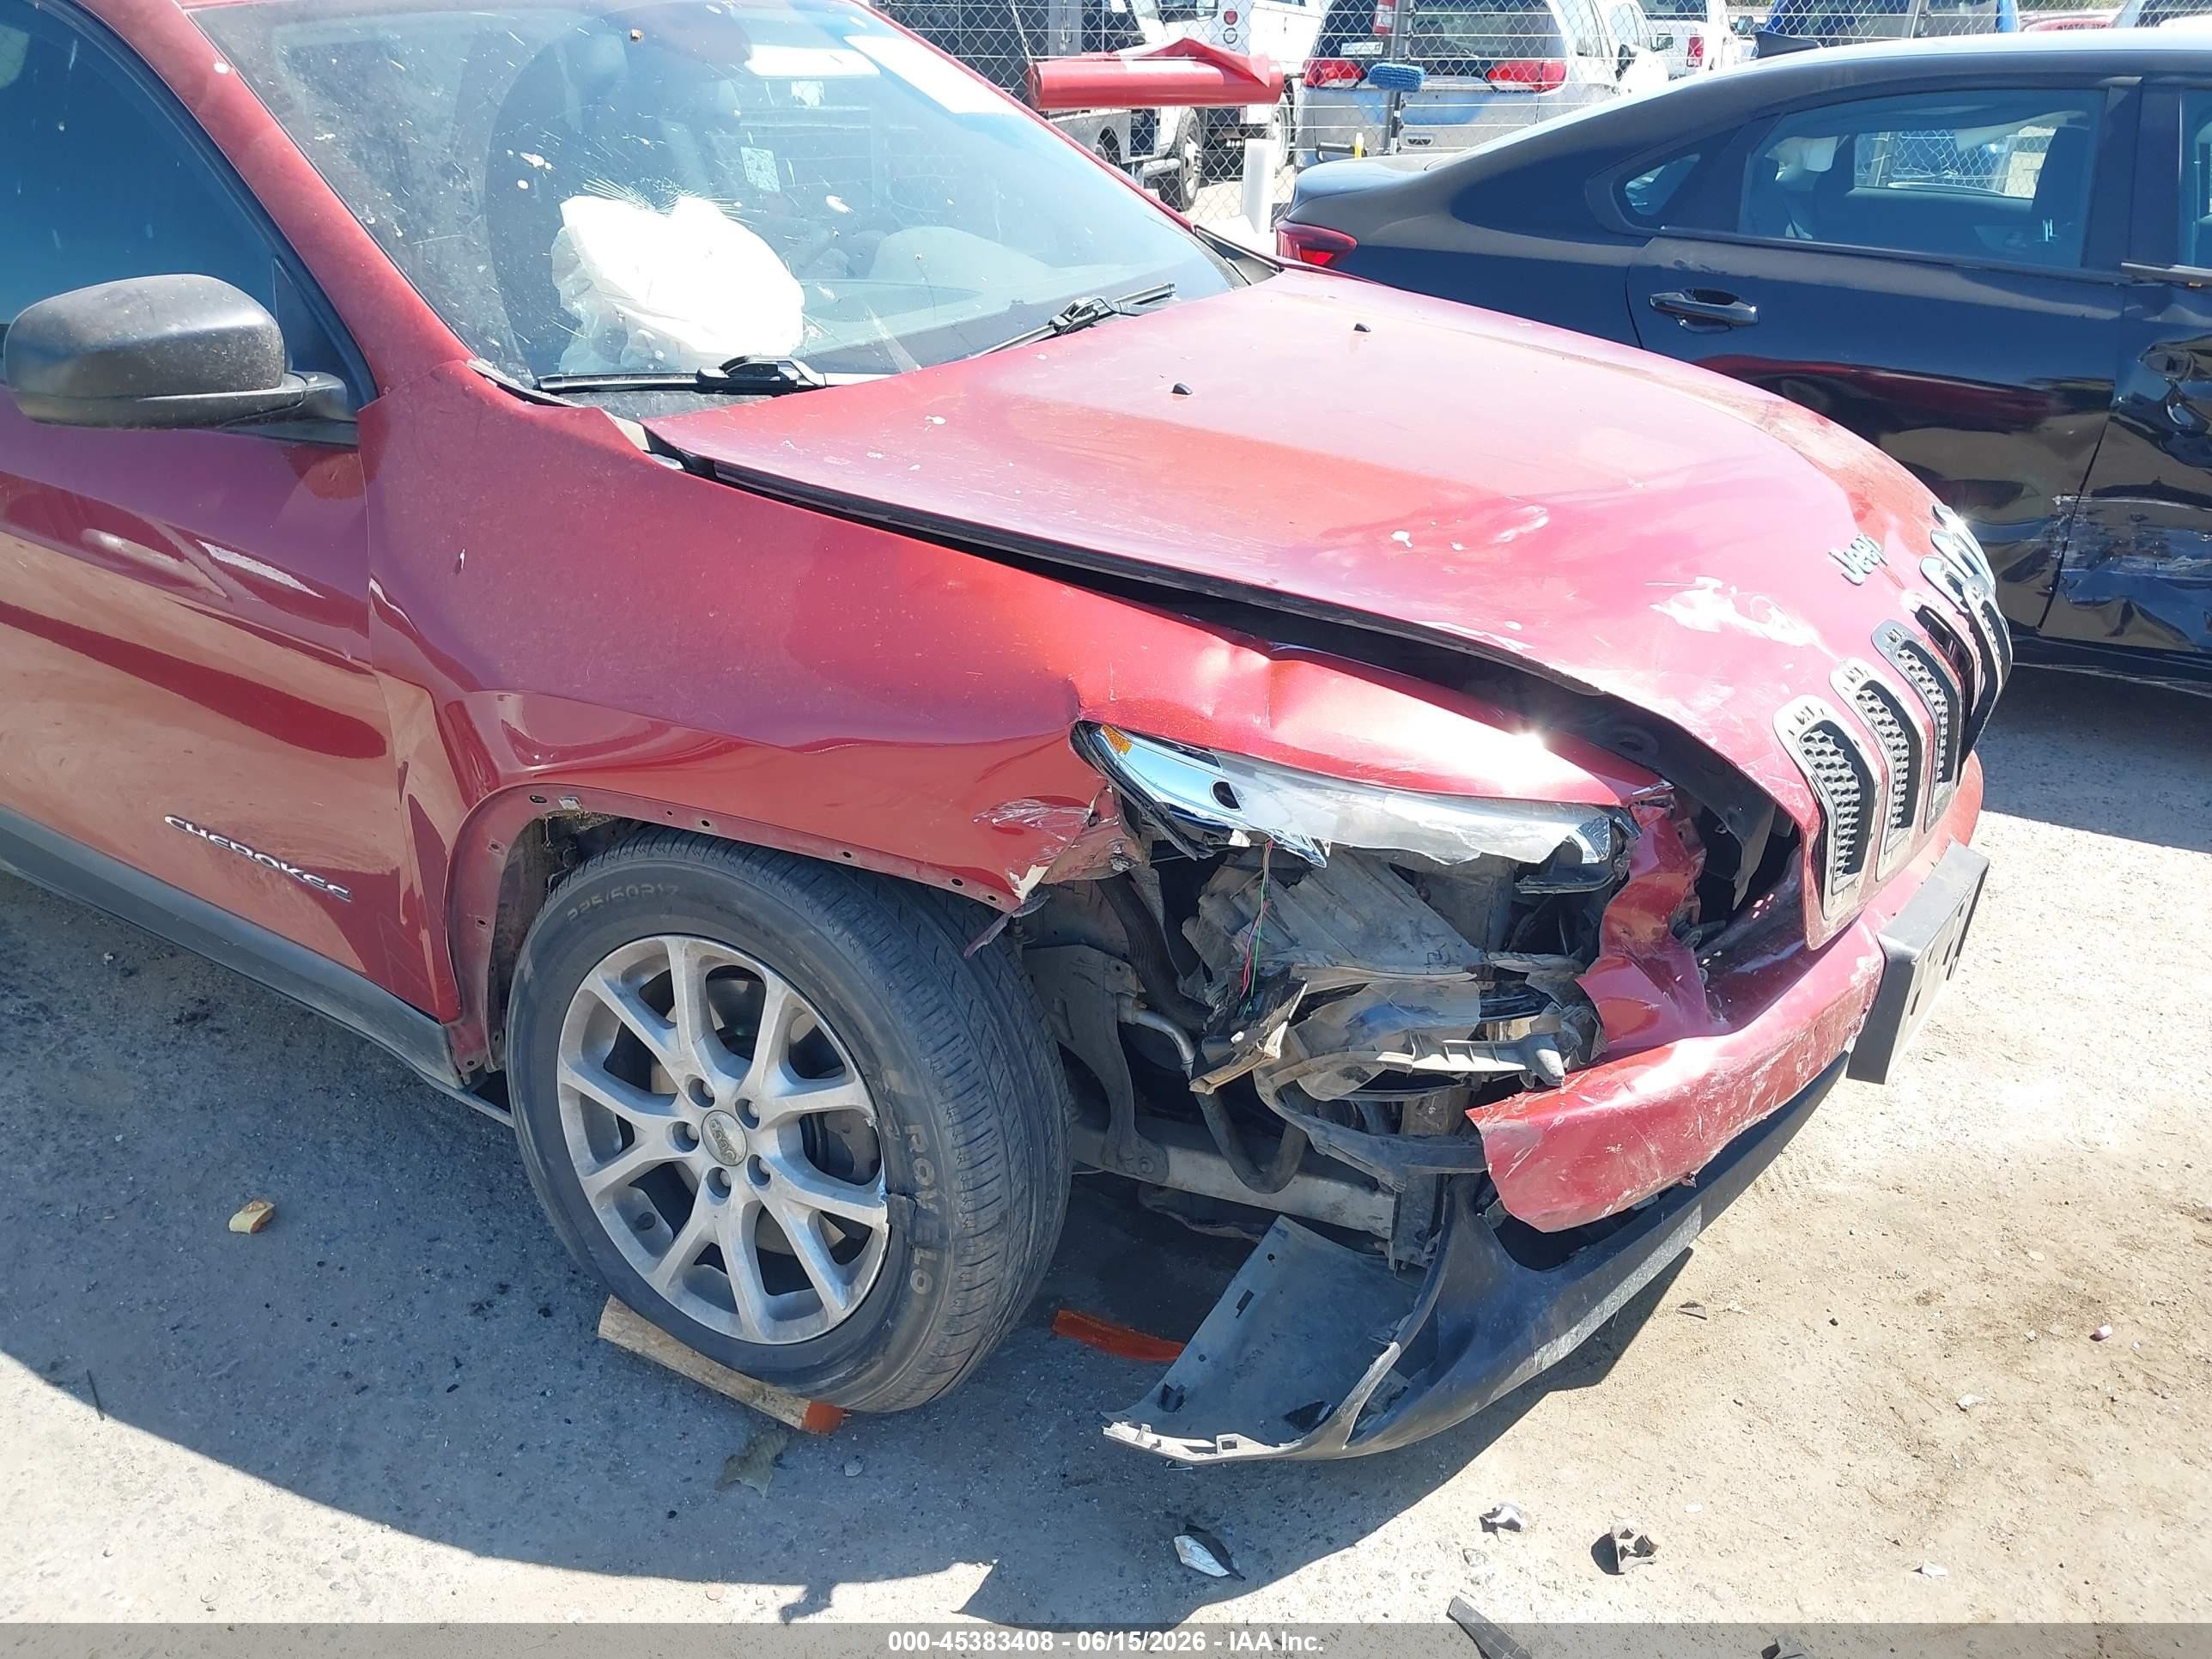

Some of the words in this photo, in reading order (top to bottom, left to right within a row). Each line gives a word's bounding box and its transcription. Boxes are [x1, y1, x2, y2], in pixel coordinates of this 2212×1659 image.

[1827, 532, 1889, 586] Jeep
[164, 814, 352, 902] CHEROKEE
[708, 1118, 737, 1163] Jeep
